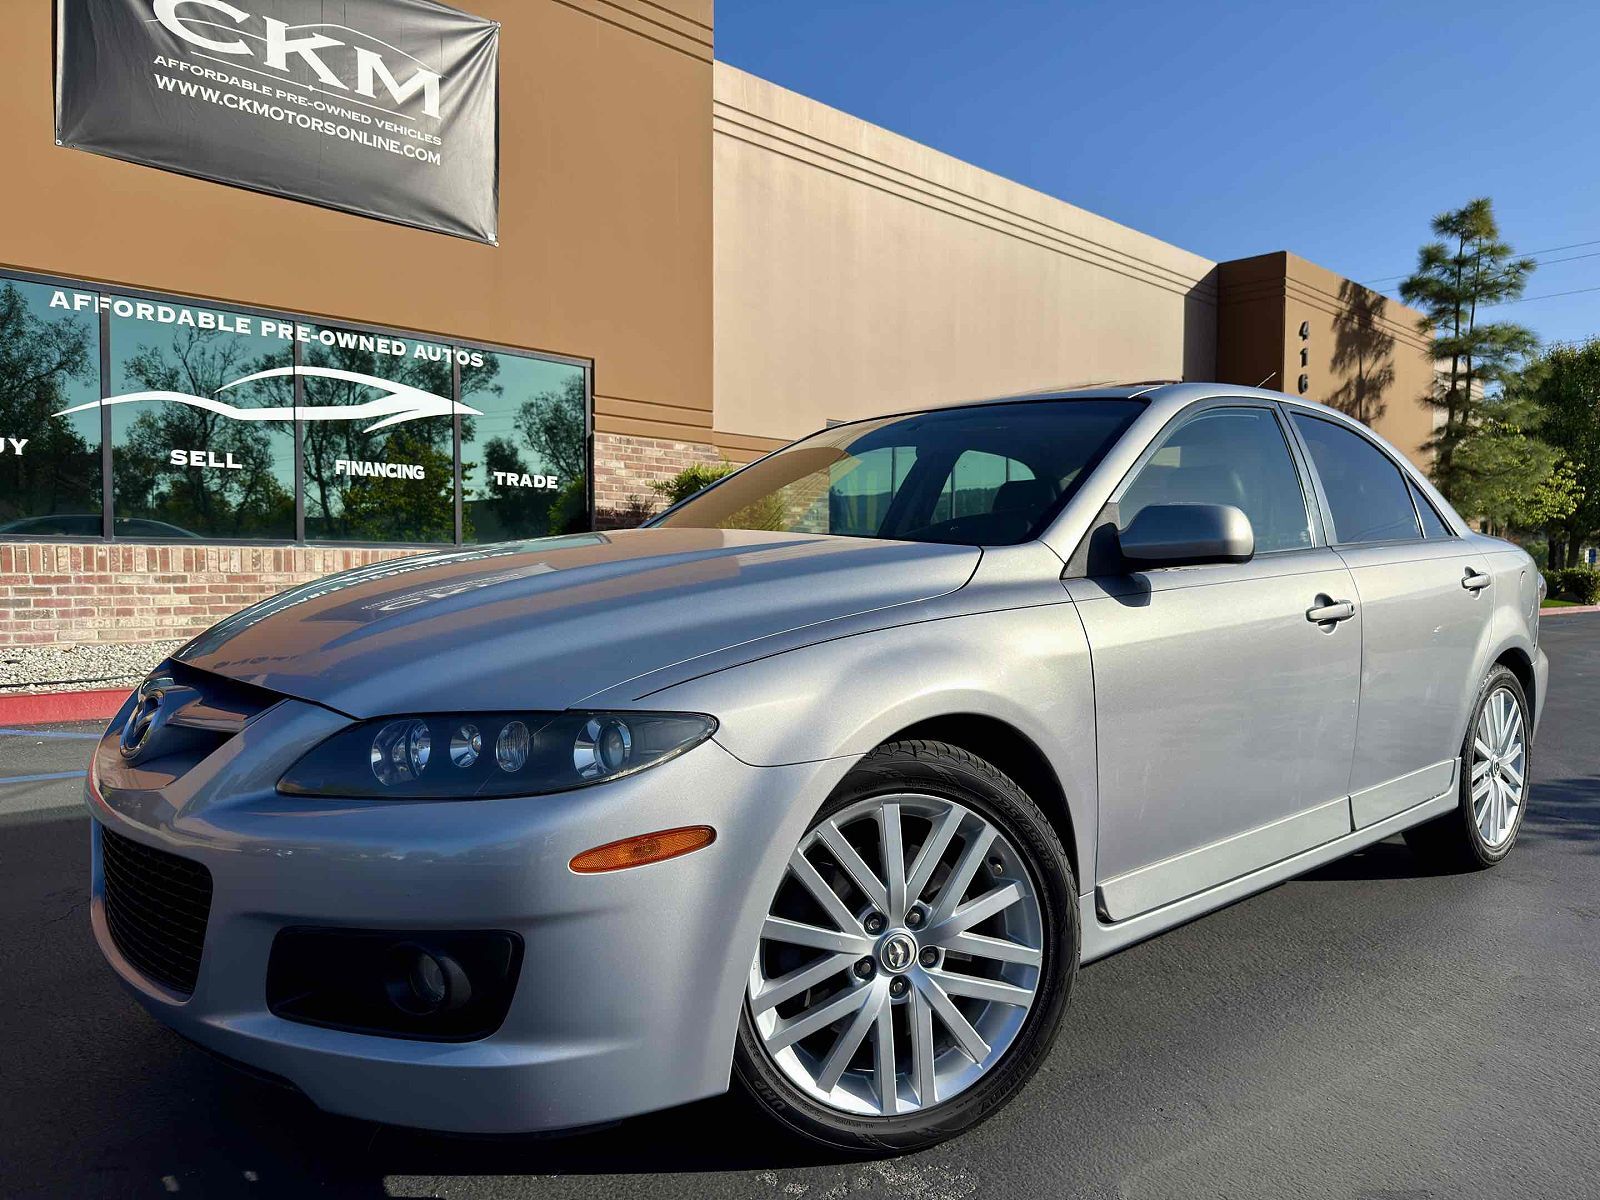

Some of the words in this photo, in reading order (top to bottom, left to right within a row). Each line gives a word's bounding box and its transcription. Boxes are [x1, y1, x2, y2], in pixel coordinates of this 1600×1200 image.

[153, 0, 442, 119] CKM
[153, 55, 272, 97] AFFORDABLE
[275, 88, 372, 125] PRE-OWNED
[374, 118, 442, 146] VEHICLES
[154, 73, 441, 166] WWW.CKMOTORSONLINE.COM
[49, 290, 252, 336] AFFORDABLE
[260, 321, 407, 357] PRE-OWNED
[413, 343, 484, 368] AUTOS
[1298, 320, 1309, 394] 416
[169, 448, 243, 470] SELL
[335, 459, 425, 480] FINANCING
[493, 471, 559, 490] TRADE
